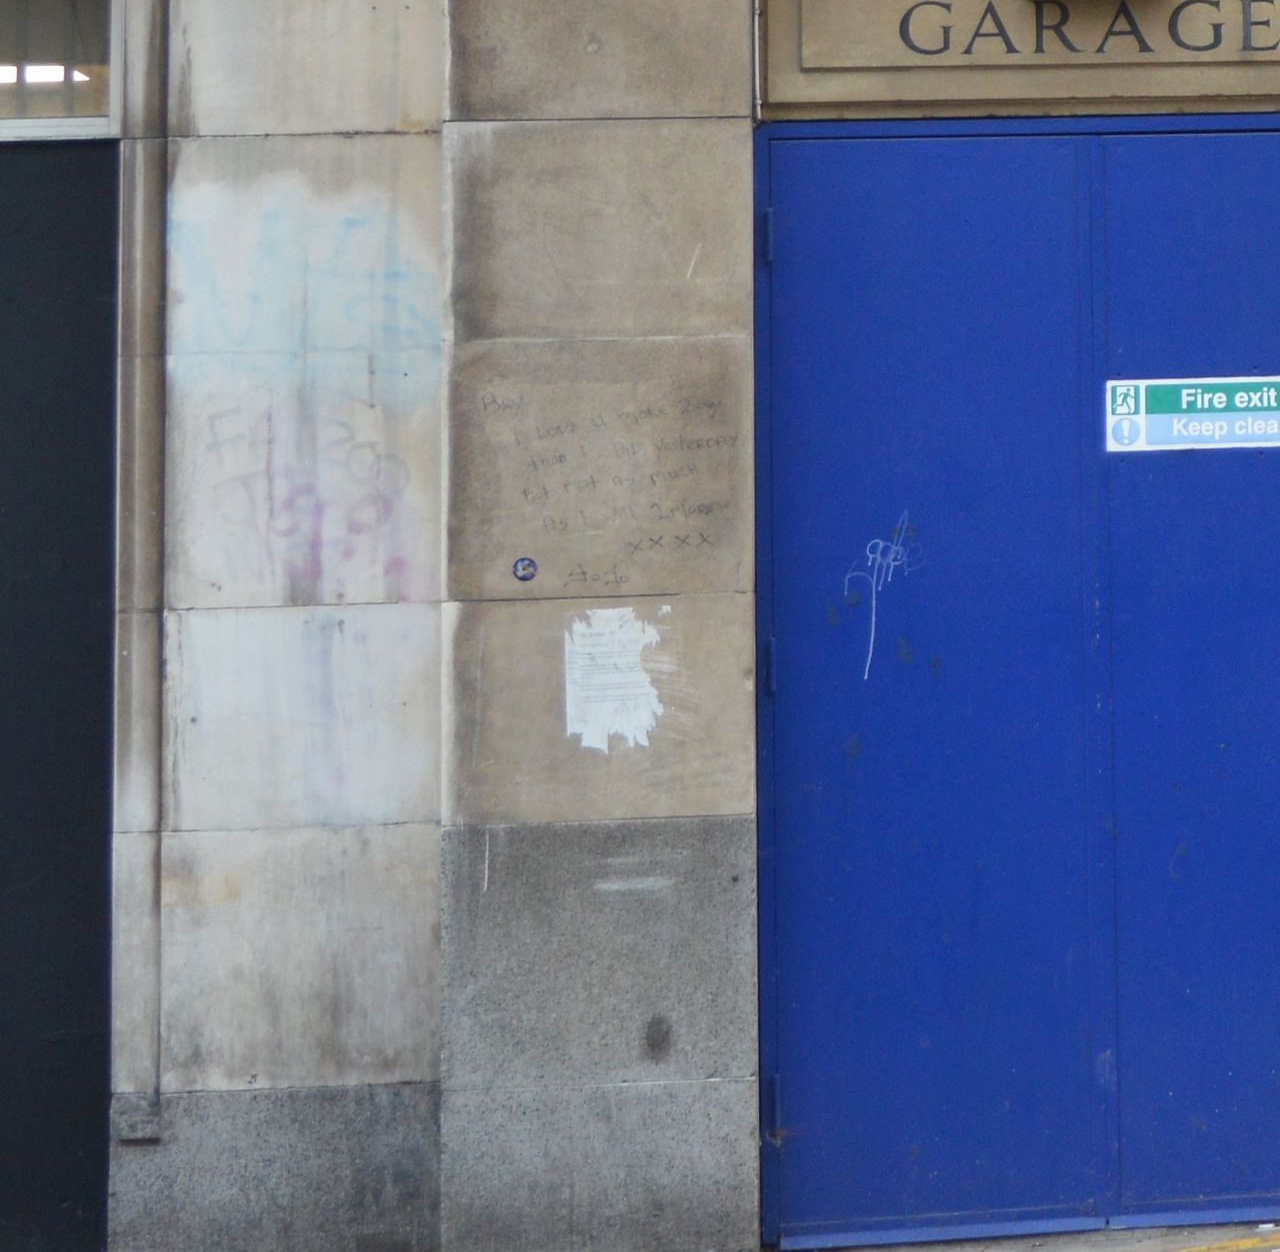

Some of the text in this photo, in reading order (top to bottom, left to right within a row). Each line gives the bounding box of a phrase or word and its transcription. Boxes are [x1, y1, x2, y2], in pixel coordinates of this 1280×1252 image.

[1181, 387, 1278, 409] Fire exit
[1172, 418, 1228, 439] Keep
